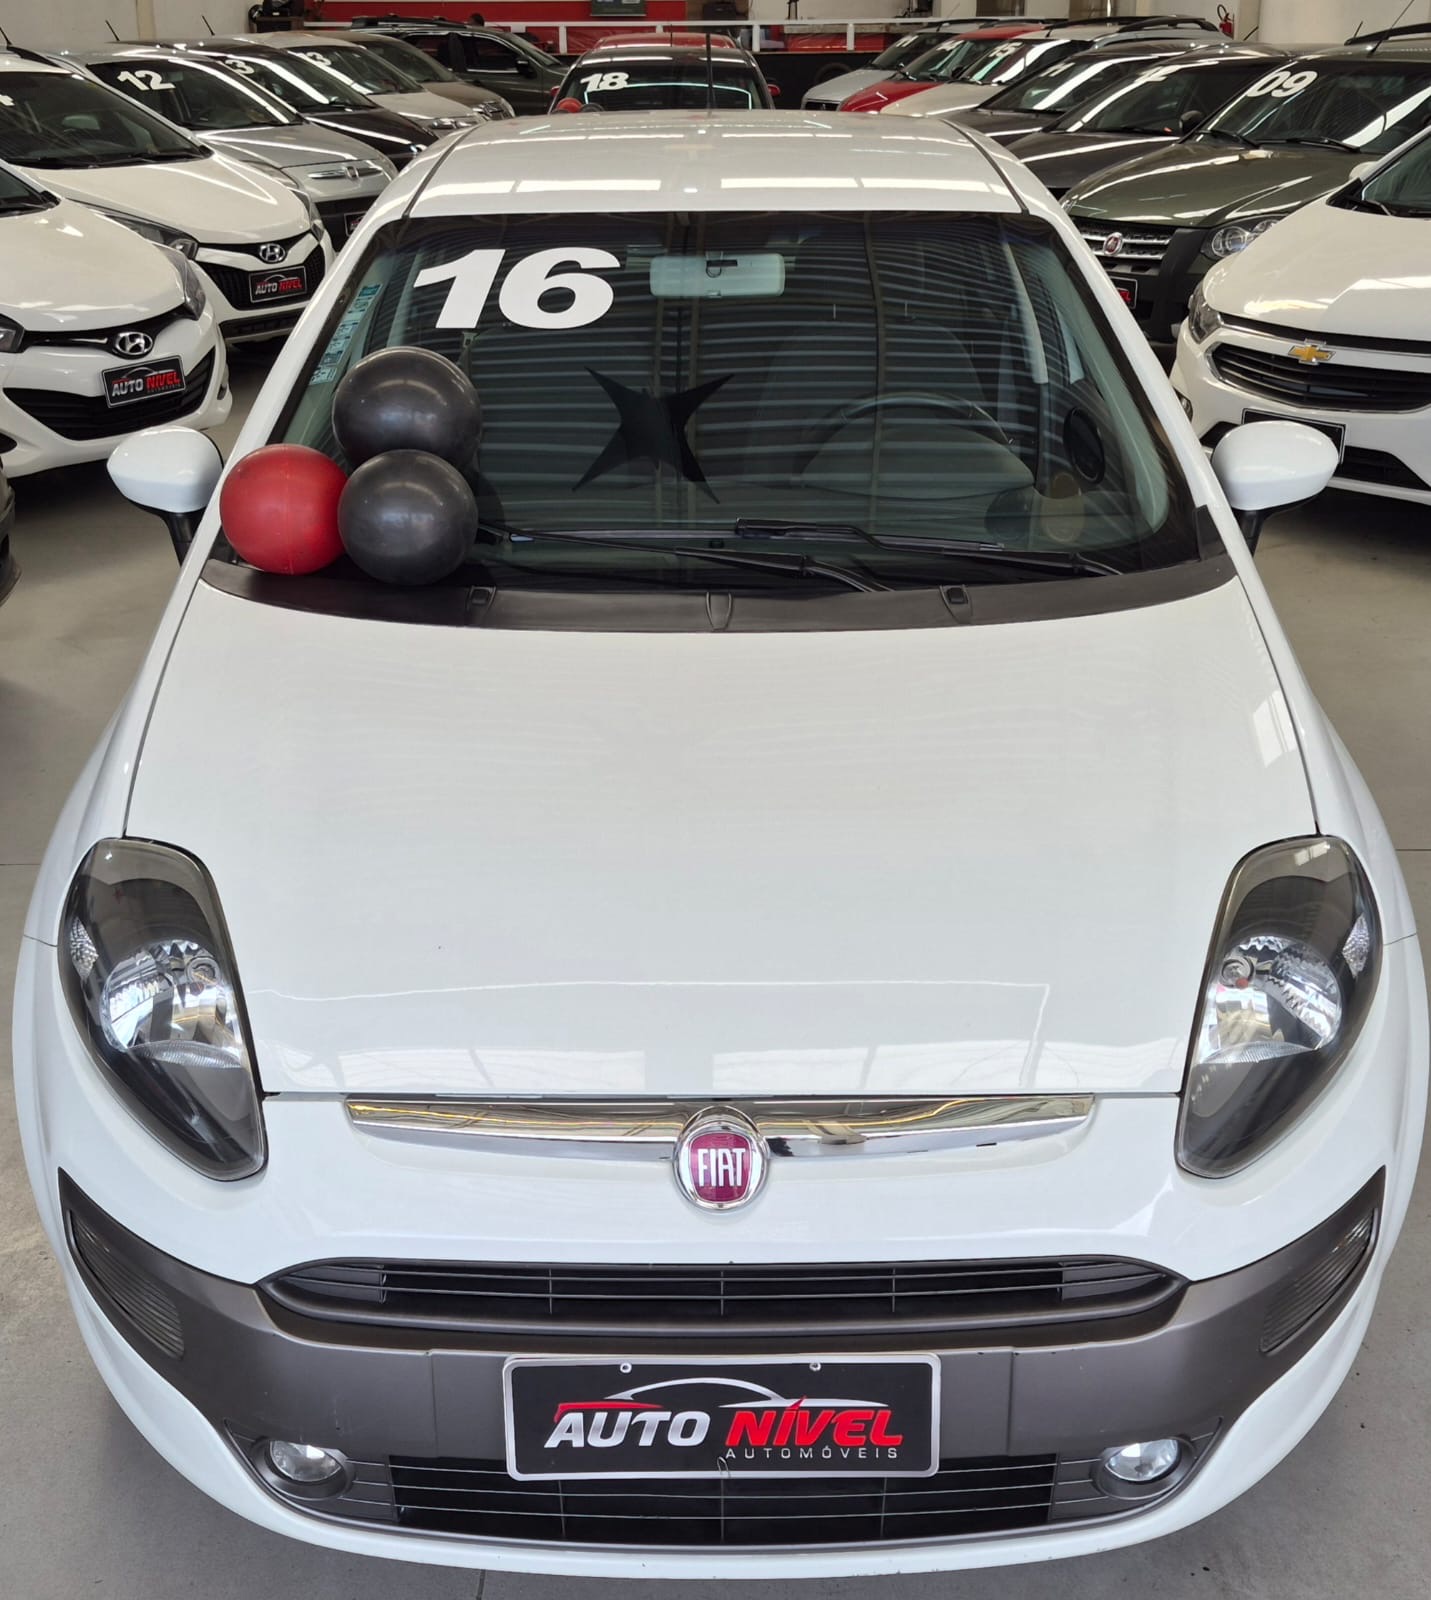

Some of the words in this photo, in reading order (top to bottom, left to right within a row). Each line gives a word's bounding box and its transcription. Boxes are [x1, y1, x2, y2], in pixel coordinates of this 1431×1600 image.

[117, 70, 176, 91] 12
[580, 72, 629, 92] 18
[1246, 71, 1318, 97] 09
[255, 282, 278, 295] AUTO
[413, 247, 620, 329] 16
[112, 379, 144, 397] AUTO
[697, 1148, 746, 1187] FIAT
[544, 1411, 711, 1449] AUTO
[725, 1396, 903, 1447] NÍVEL
[725, 1446, 898, 1459] AUTOMÓVEIS
